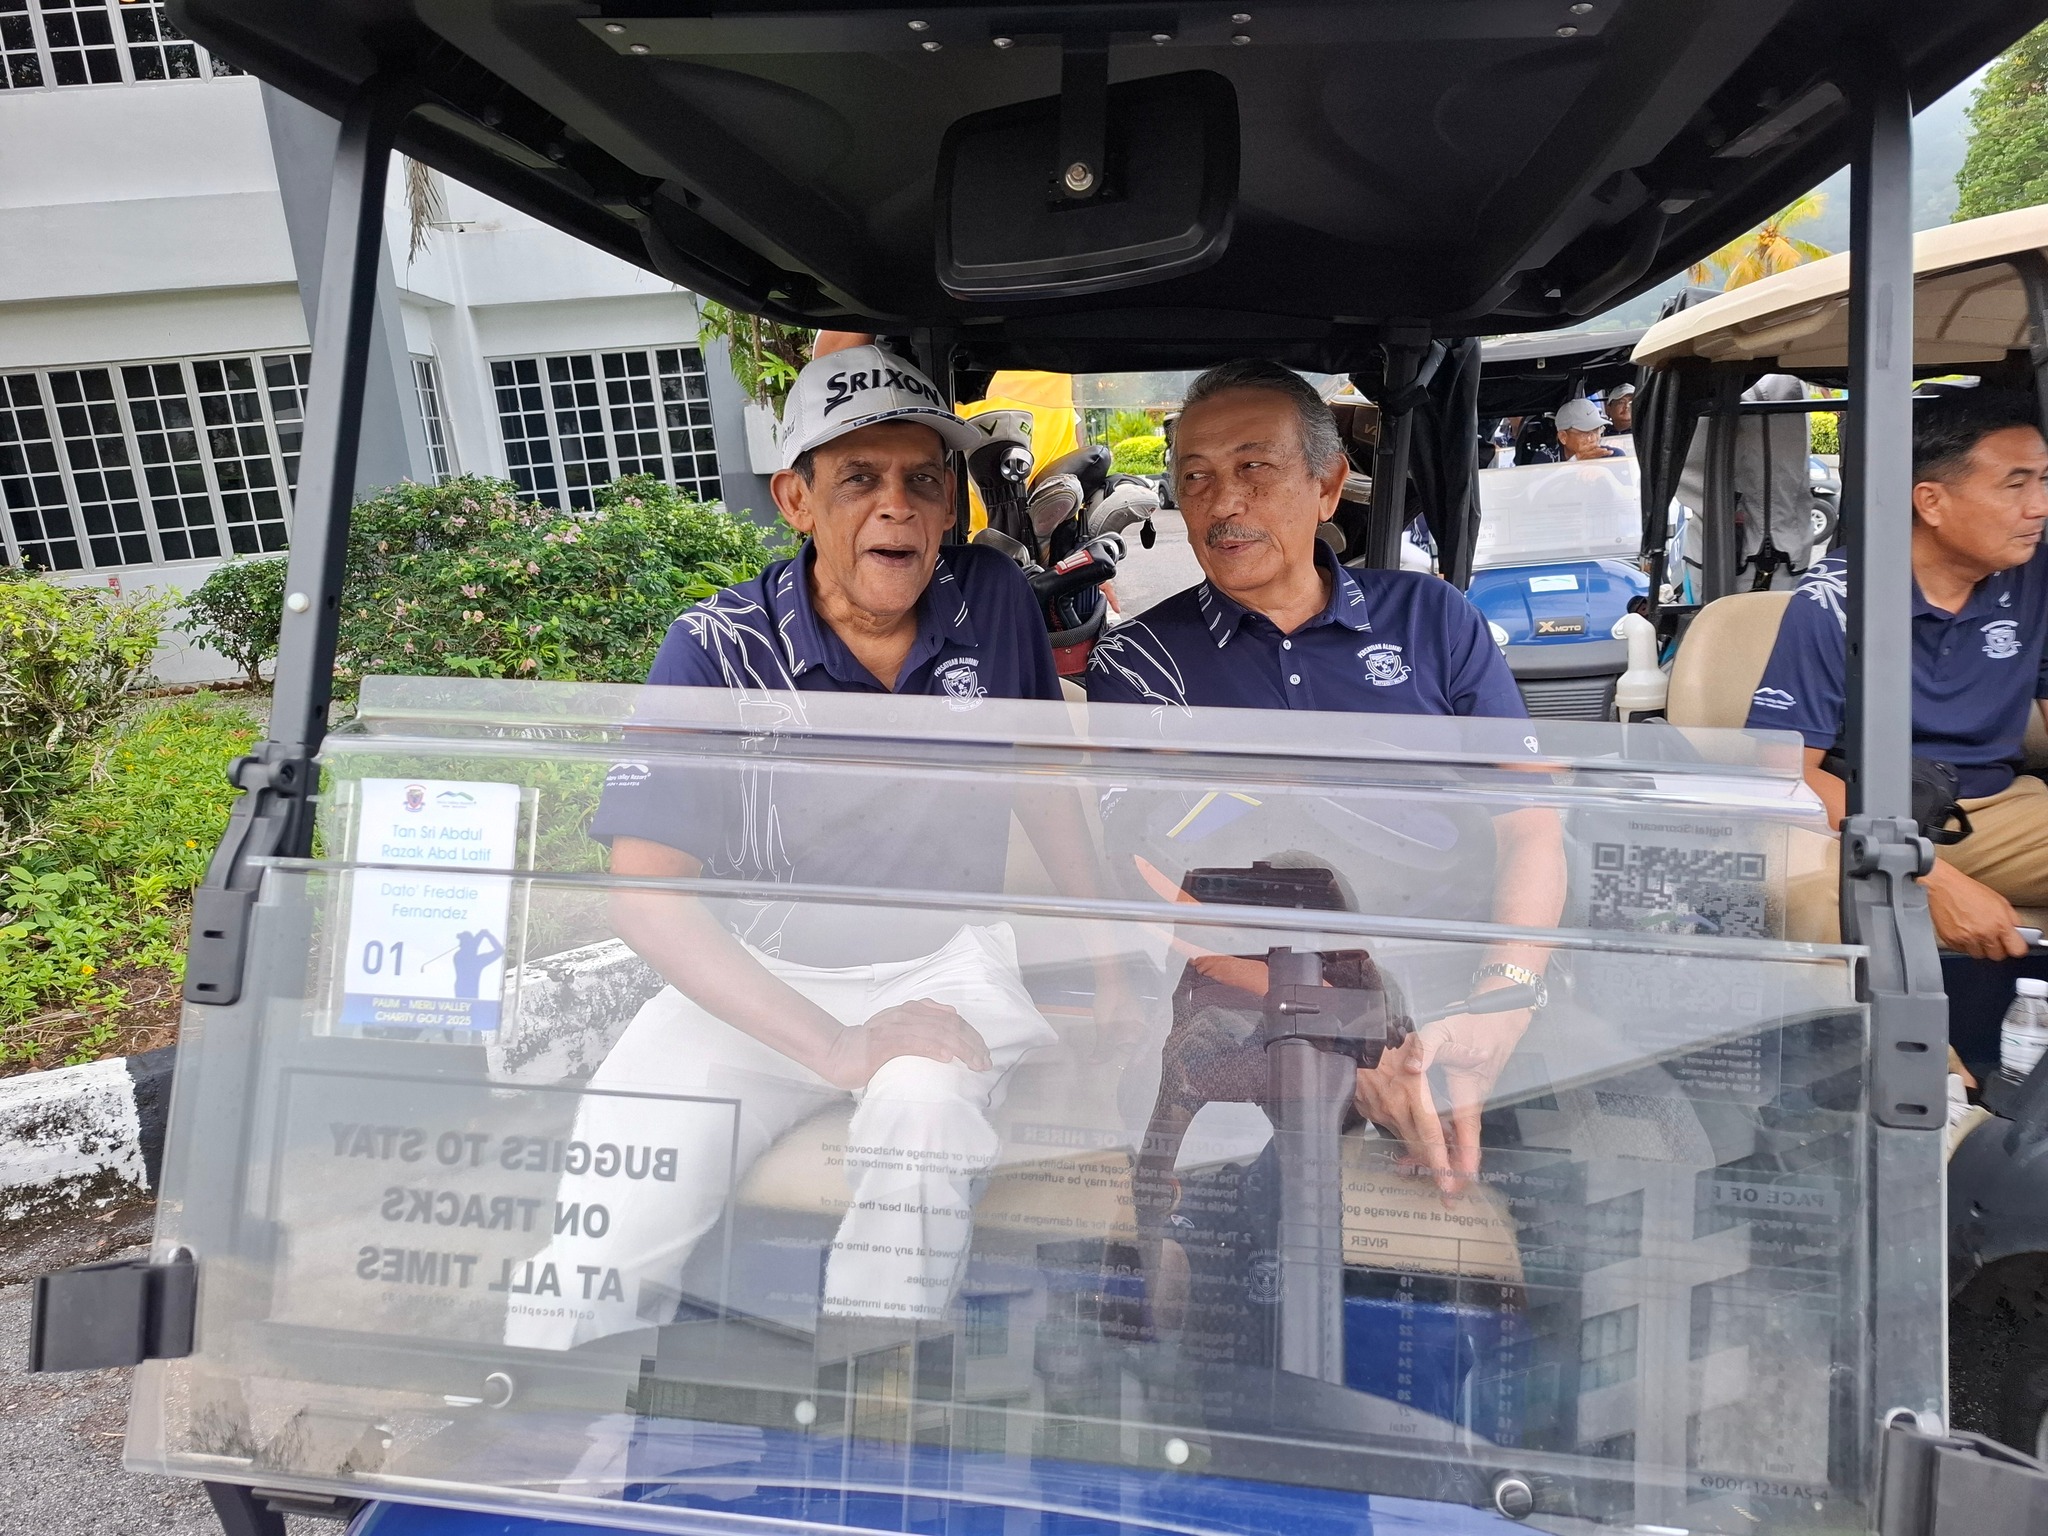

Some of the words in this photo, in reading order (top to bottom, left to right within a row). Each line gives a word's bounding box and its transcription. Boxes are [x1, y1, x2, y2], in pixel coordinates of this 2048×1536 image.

[824, 369, 940, 417] SRIXON
[393, 824, 417, 839] Tan
[420, 825, 436, 839] Sri
[439, 826, 483, 841] Abdul
[381, 845, 423, 859] Razak
[427, 846, 457, 861] Abd
[461, 847, 491, 862] Latif
[380, 883, 420, 898] Dato'
[423, 885, 478, 901] Freddie
[392, 904, 467, 920] Fernandez
[362, 940, 404, 976] 01
[409, 999, 437, 1011] MERU
[438, 1001, 472, 1013] VALLEY
[375, 1011, 415, 1024] CHARITY
[416, 1013, 444, 1025] GOLF
[446, 1014, 472, 1026] 2025
